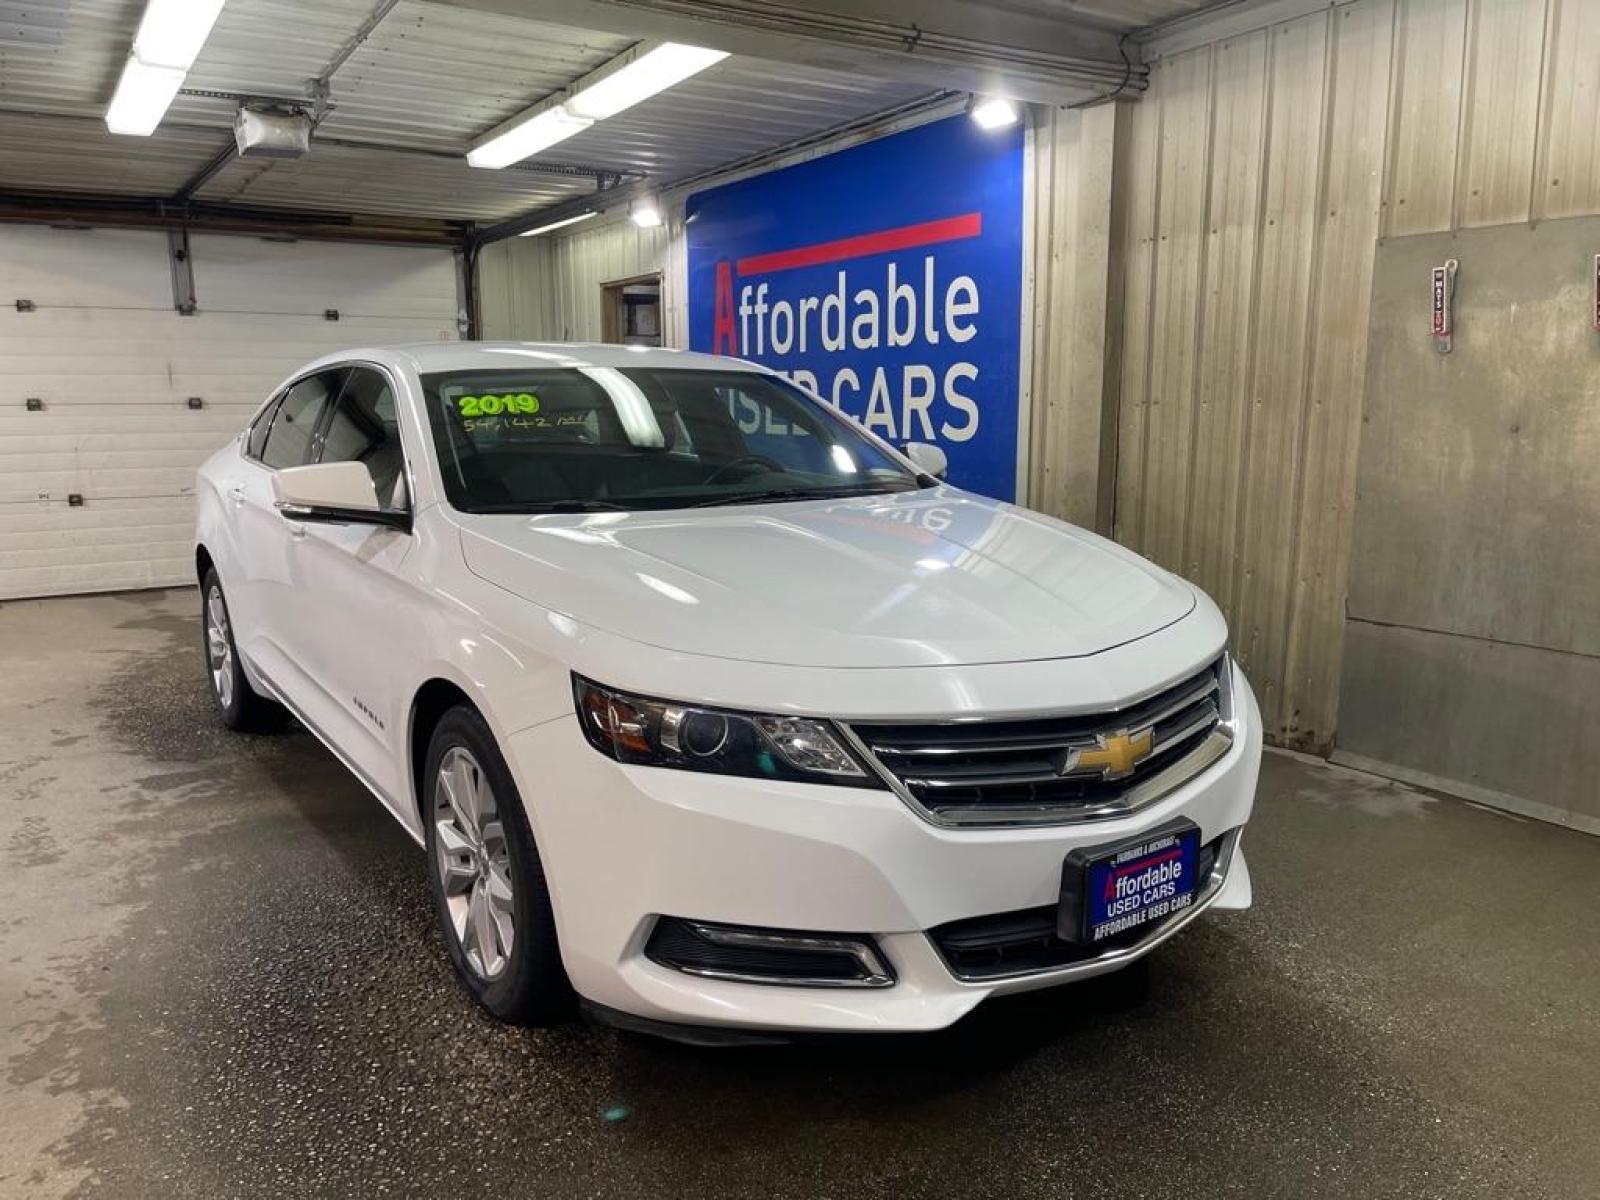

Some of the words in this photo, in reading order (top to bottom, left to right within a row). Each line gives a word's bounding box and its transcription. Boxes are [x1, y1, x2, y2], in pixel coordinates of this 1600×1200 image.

[714, 257, 980, 358] Affordable
[459, 394, 539, 416] 2019
[832, 363, 979, 442] CARS
[1104, 860, 1182, 902] Affordable
[1107, 894, 1140, 918] USED
[1143, 881, 1176, 904] CARS
[1094, 909, 1147, 941] AFFORDABLE
[1148, 901, 1169, 920] USED
[1171, 893, 1192, 912] CARS
